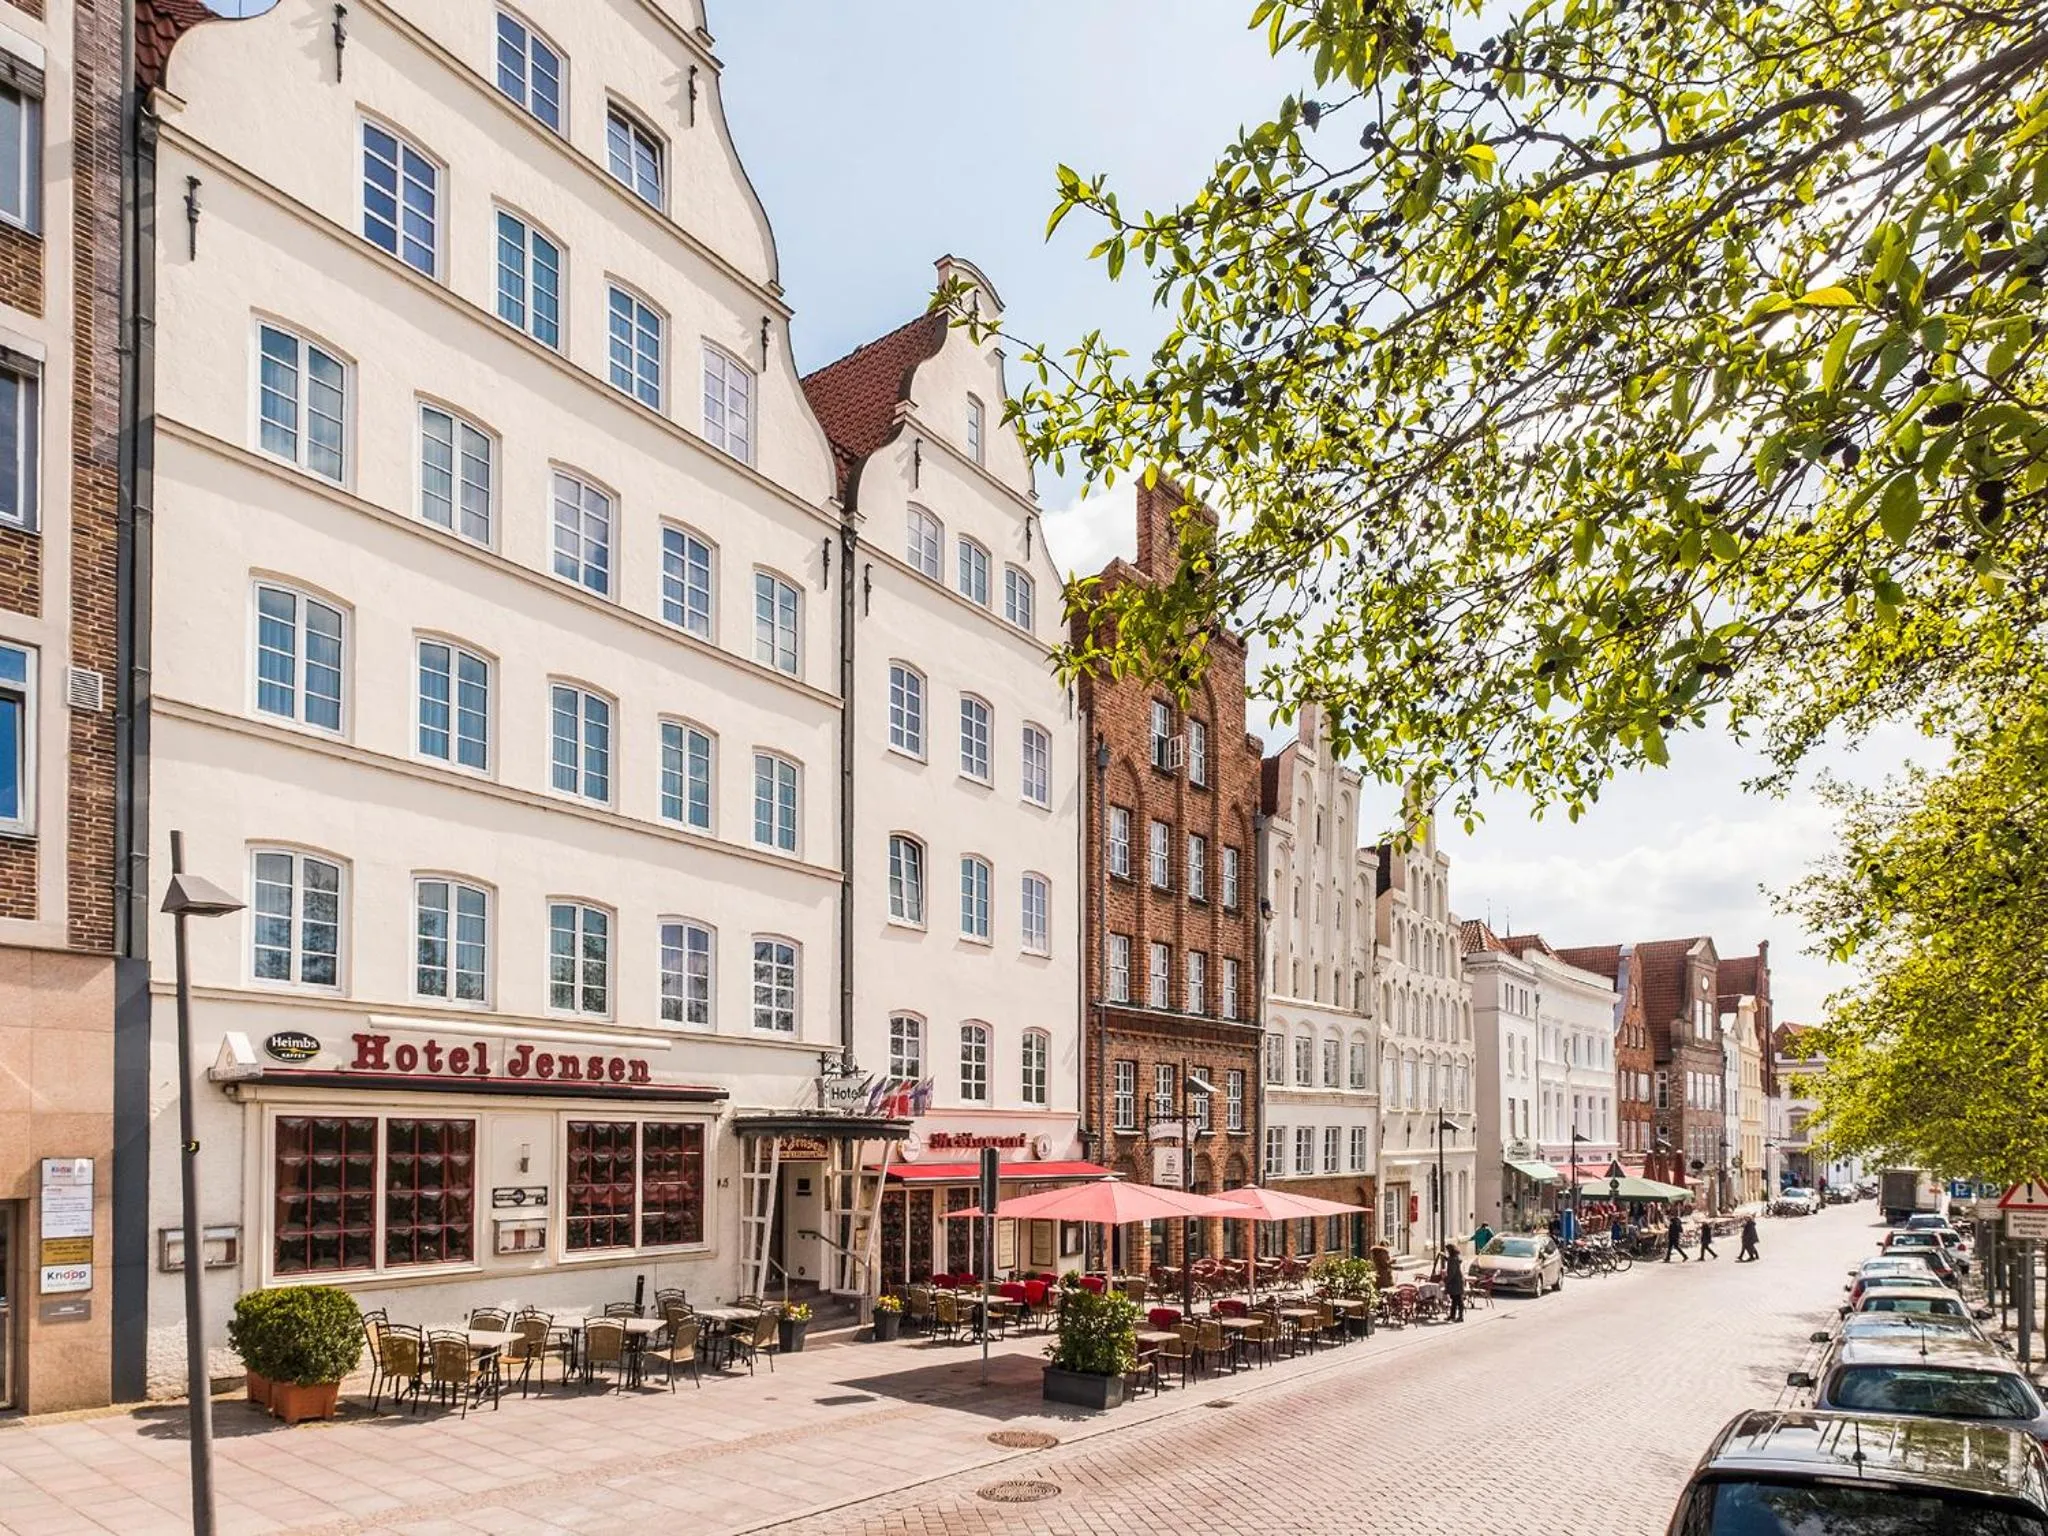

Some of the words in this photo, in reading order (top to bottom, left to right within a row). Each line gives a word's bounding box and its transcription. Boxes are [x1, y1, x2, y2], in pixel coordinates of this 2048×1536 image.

[272, 1037, 317, 1048] Heimbs
[352, 1034, 491, 1075] Hotel
[508, 1045, 651, 1082] Jensen
